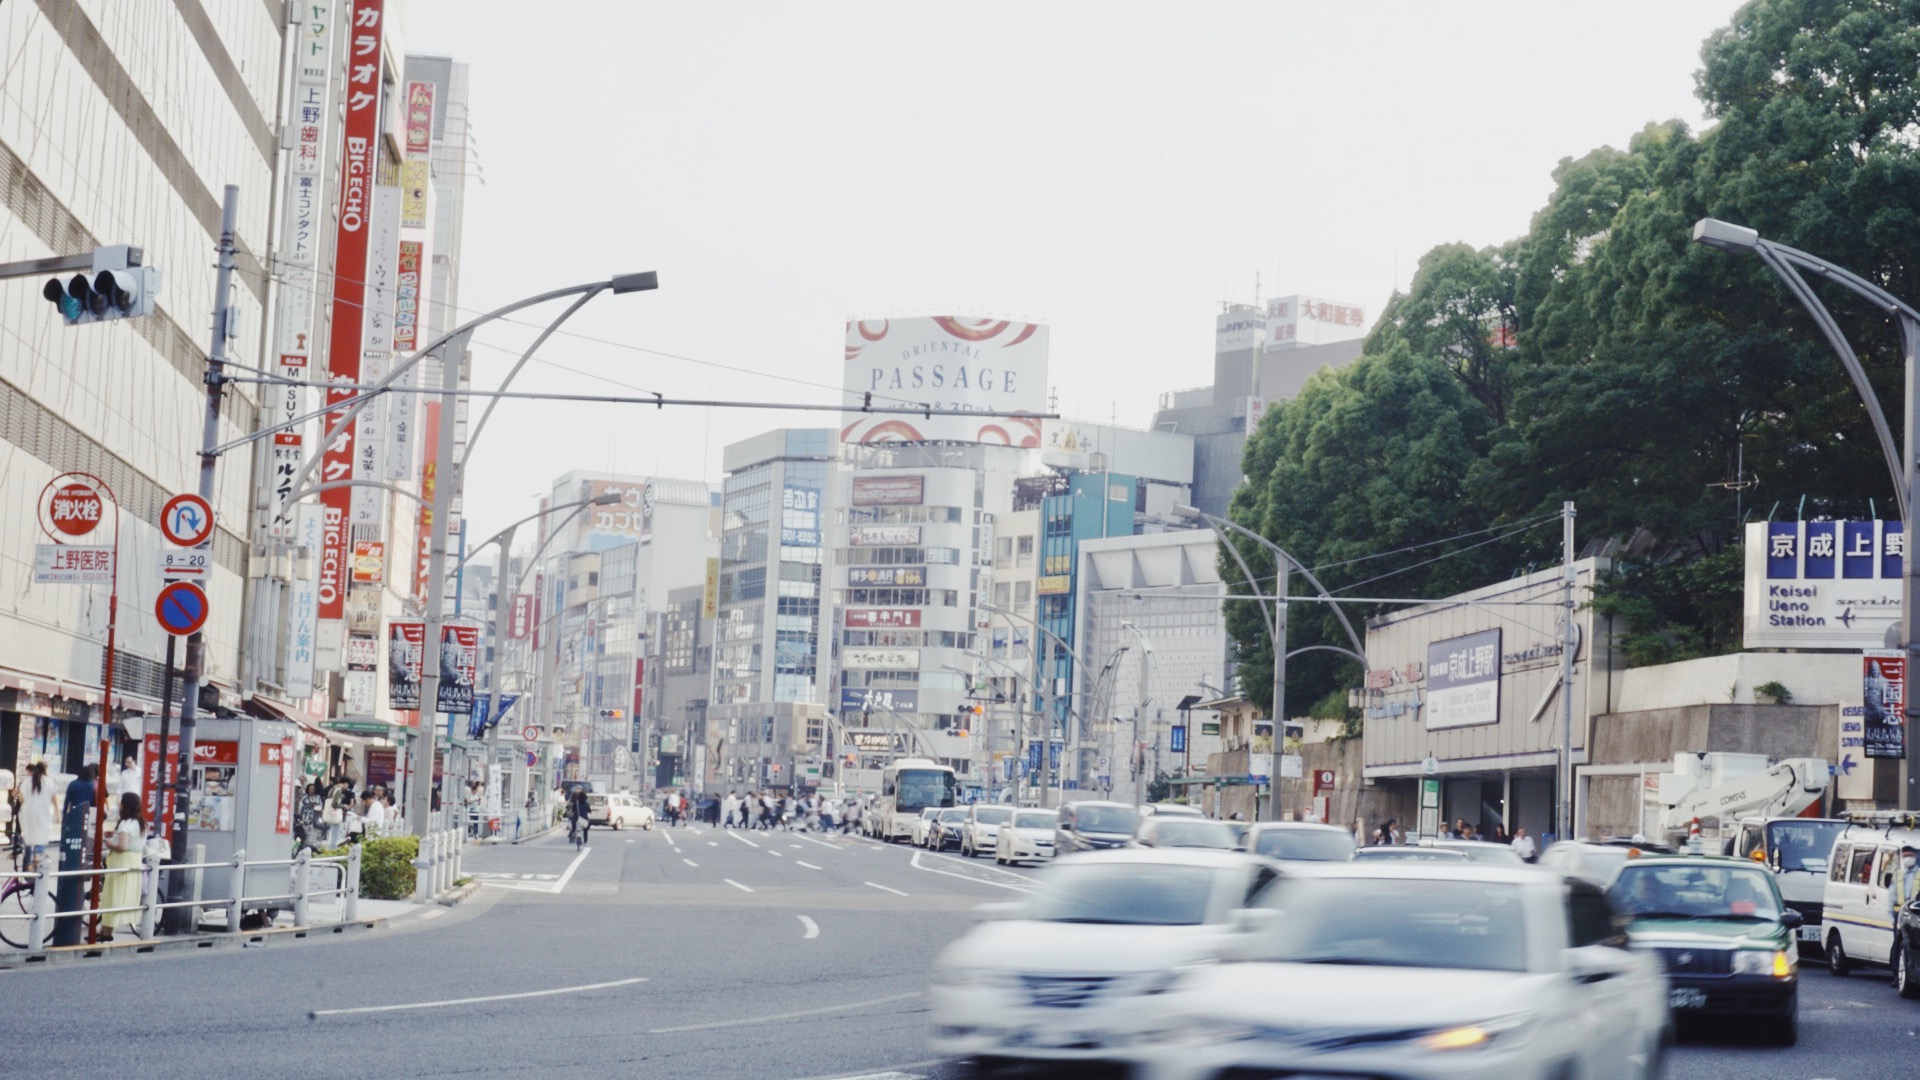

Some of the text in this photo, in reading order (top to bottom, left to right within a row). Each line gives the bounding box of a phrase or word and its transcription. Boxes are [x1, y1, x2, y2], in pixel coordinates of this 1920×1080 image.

[311, 5, 326, 56] ヤマト
[350, 7, 379, 111] カラオケ
[299, 88, 321, 161] 上野歯科
[342, 136, 367, 232] BIG ECHO
[297, 177, 313, 251] 富士コンタクト
[293, 253, 309, 261] 4F
[1301, 300, 1366, 327] 大和証券
[371, 336, 383, 345] 5F
[903, 341, 981, 360] ORIENTAL
[284, 357, 303, 365] BAG
[870, 365, 1018, 393] PASSAGE
[363, 427, 376, 435] 4F
[54, 499, 100, 521] 消火栓
[360, 512, 372, 520] 3F
[319, 506, 342, 605] BIG ECHO
[1770, 532, 1904, 558] 京成上野
[51, 550, 109, 571] 上野医院
[1769, 585, 1818, 598] Keisei
[1769, 600, 1809, 612] Ueno
[1769, 614, 1826, 627] Station
[351, 641, 376, 649] 大学生
[404, 626, 423, 682] 三国志
[455, 629, 478, 686] 三国志
[1449, 644, 1494, 681] 京成上野駅
[1882, 661, 1904, 725] 三国志
[1842, 722, 1862, 732] UENO
[964, 790, 973, 802] P
[1720, 791, 1747, 806] COMSYS
